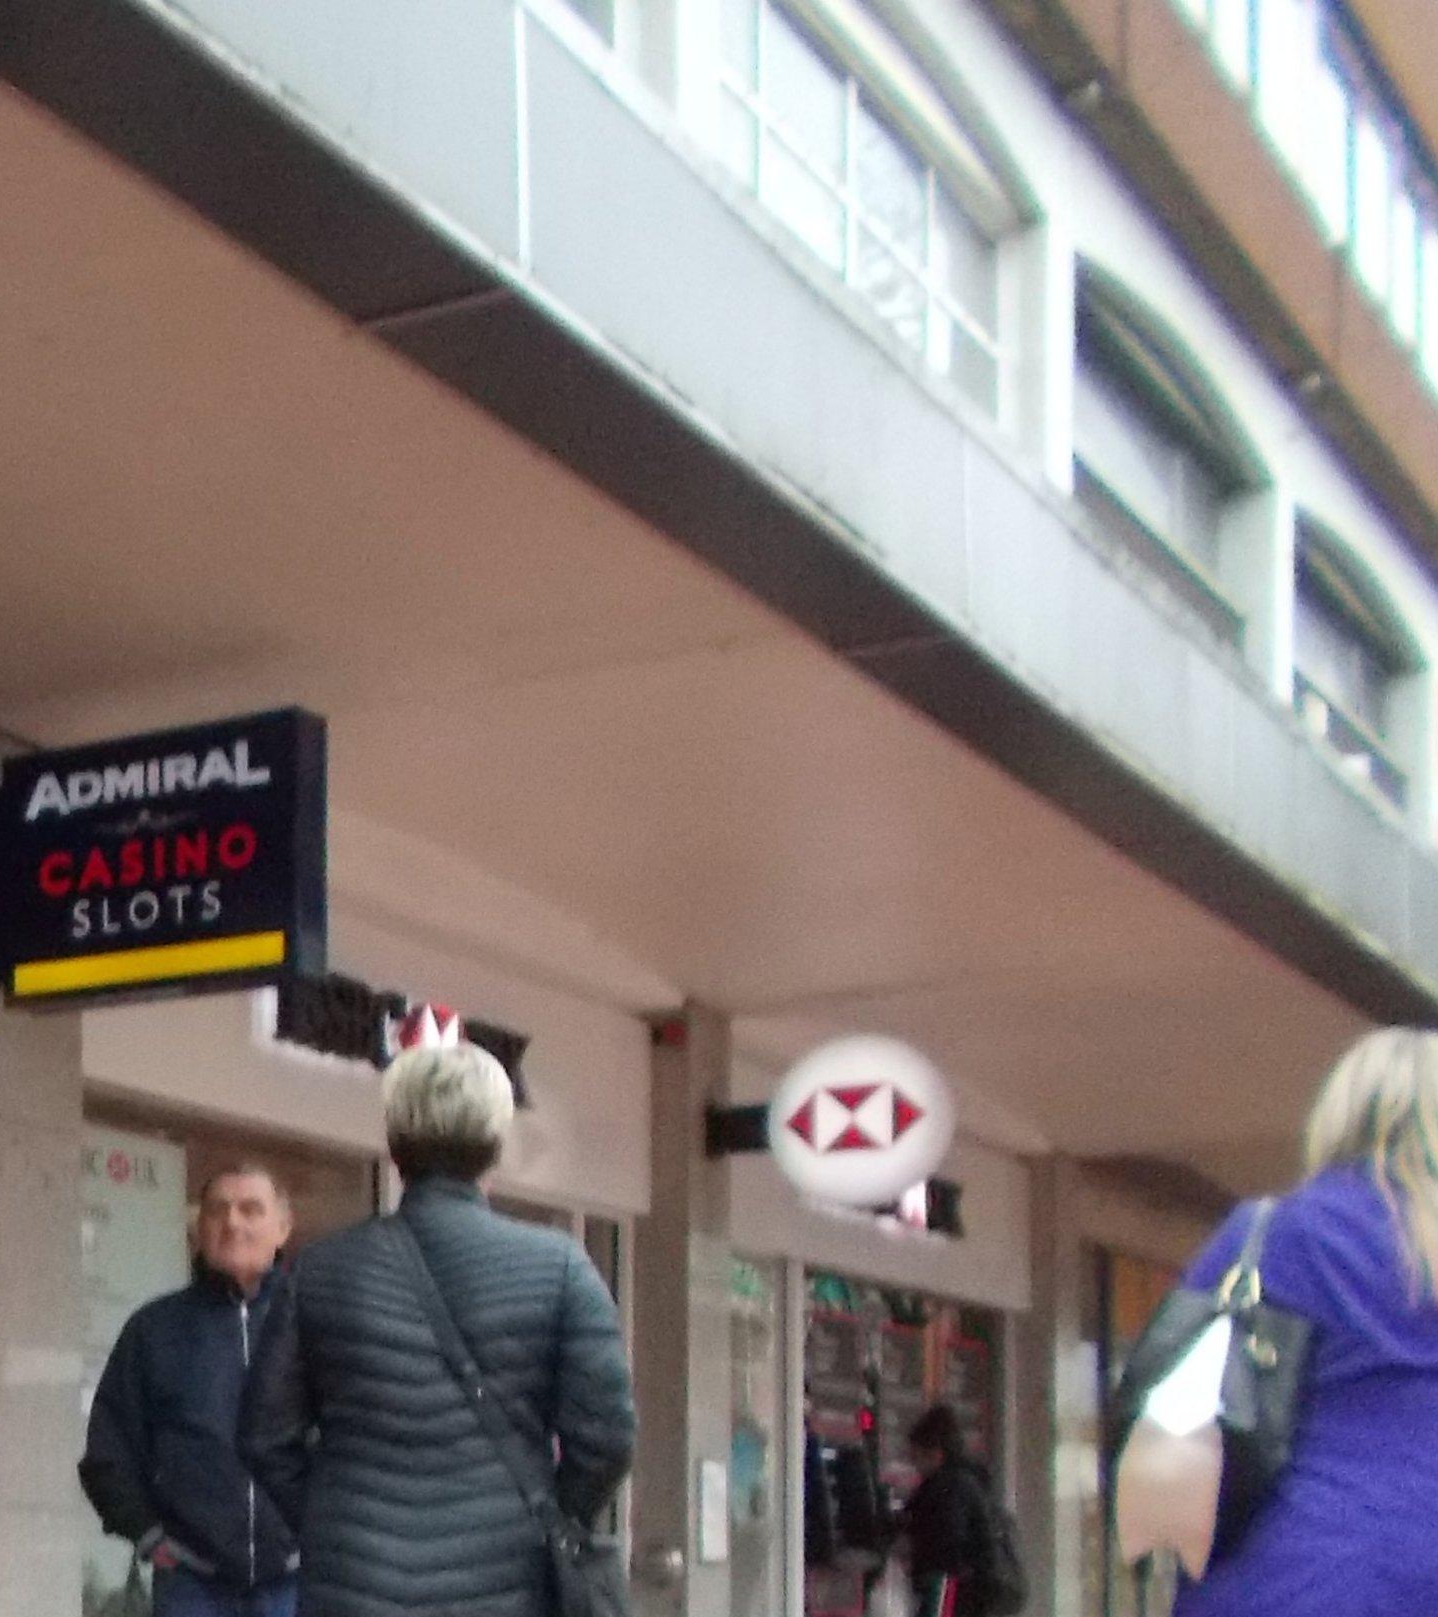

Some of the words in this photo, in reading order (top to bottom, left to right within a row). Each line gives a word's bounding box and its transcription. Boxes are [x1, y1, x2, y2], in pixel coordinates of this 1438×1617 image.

[26, 740, 270, 821] ADMIRAL
[40, 823, 256, 896] CASINO
[72, 880, 223, 939] SLOTS
